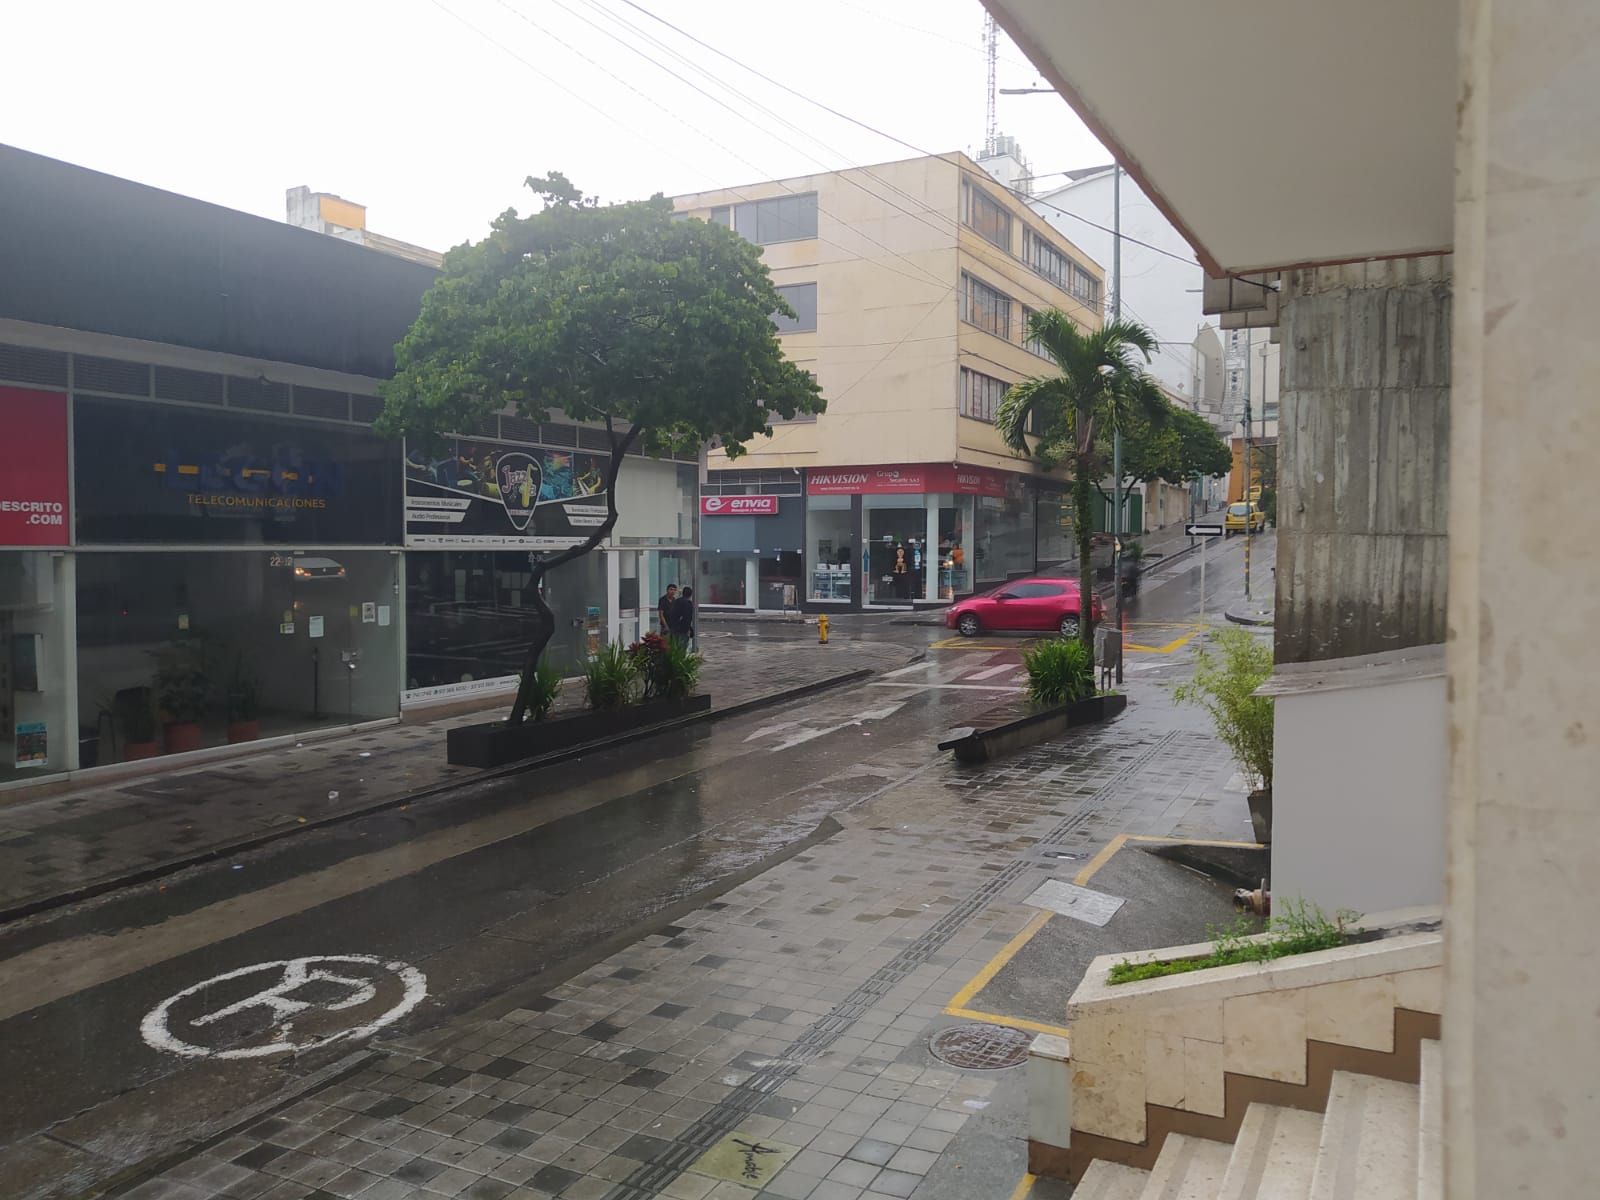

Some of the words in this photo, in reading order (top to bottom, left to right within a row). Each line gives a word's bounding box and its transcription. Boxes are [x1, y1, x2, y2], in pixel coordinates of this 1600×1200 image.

[811, 473, 868, 484] HIKVISION
[0, 500, 62, 513] ESCRITO
[187, 494, 327, 509] TELECOMUNICACIONES
[26, 513, 62, 525] .COM
